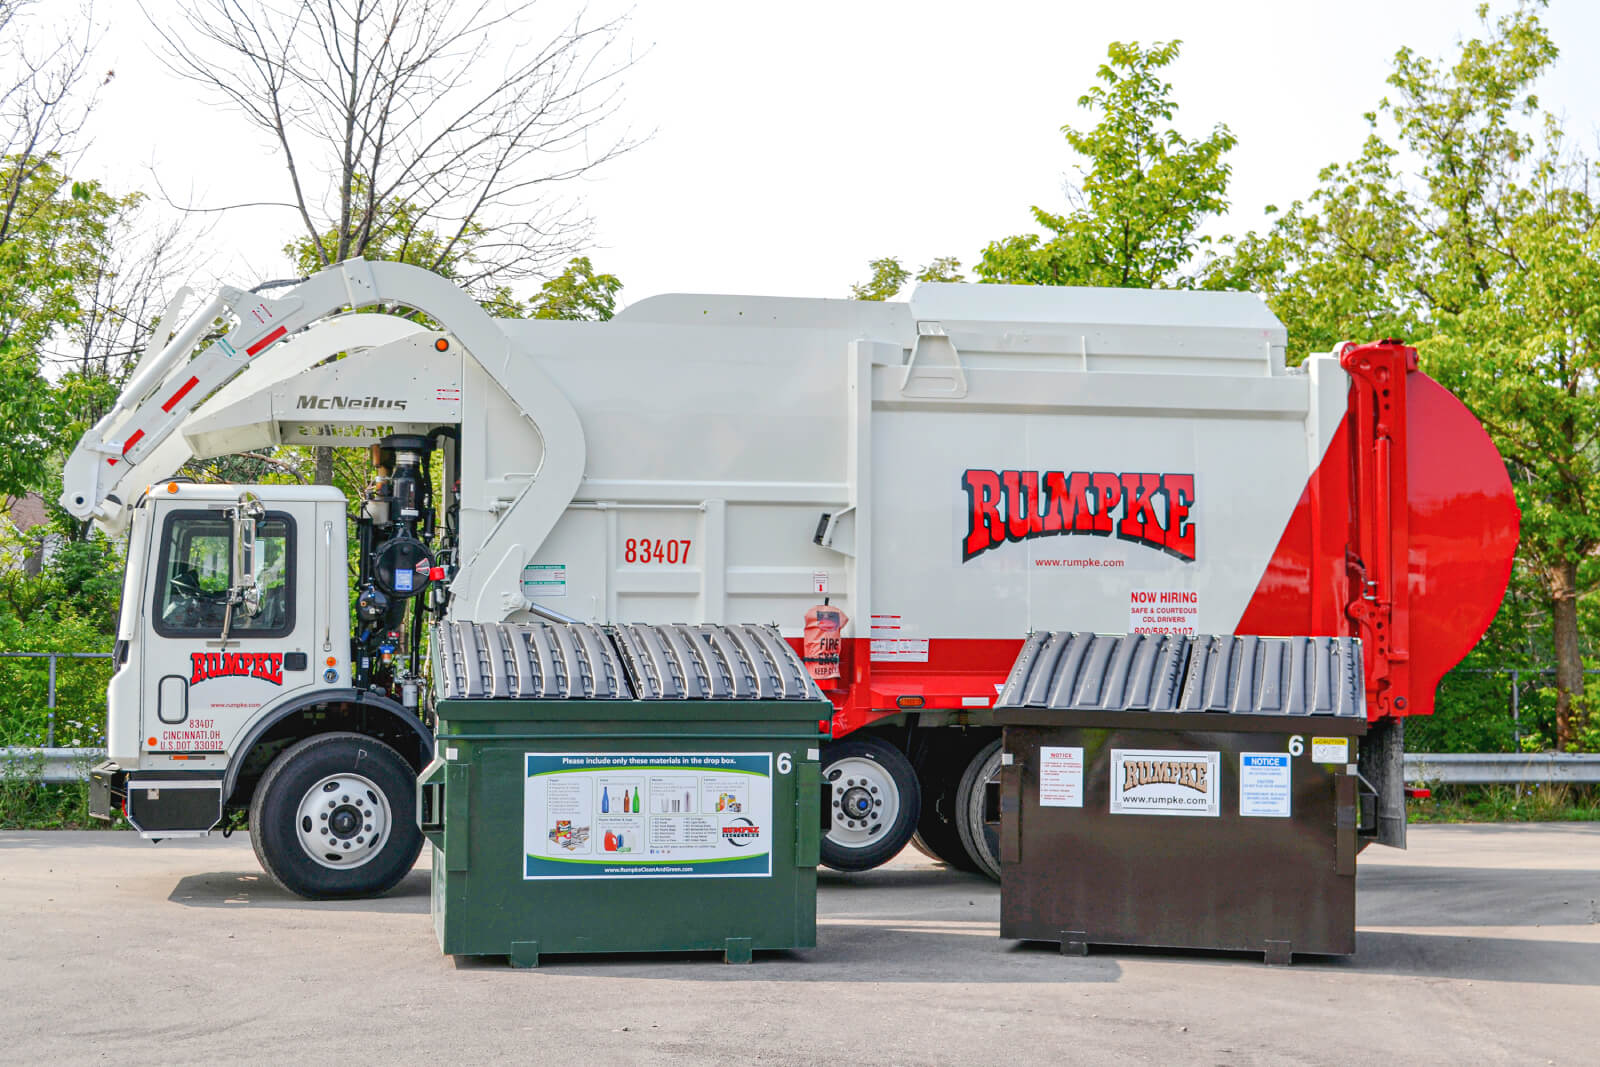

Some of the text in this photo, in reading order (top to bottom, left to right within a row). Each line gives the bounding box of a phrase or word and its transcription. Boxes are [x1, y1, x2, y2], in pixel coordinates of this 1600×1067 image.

[296, 395, 408, 411] McNeilus
[962, 469, 1196, 564] RUMPKE
[625, 538, 692, 564] 83407
[1035, 558, 1125, 568] www.rumpke.com
[1131, 591, 1197, 603] NOW HIRING
[820, 637, 839, 652] FIRE
[189, 652, 283, 687] RUMPKE
[189, 719, 214, 729] 83407
[194, 740, 224, 750] 330912
[1288, 735, 1304, 757] 6
[562, 757, 736, 767] Please include only these materials in the drop box.
[776, 752, 792, 775] 6
[1251, 757, 1280, 767] NOTICE
[1123, 760, 1207, 793] RUMPKE
[1122, 796, 1207, 806] www.rumpke.com
